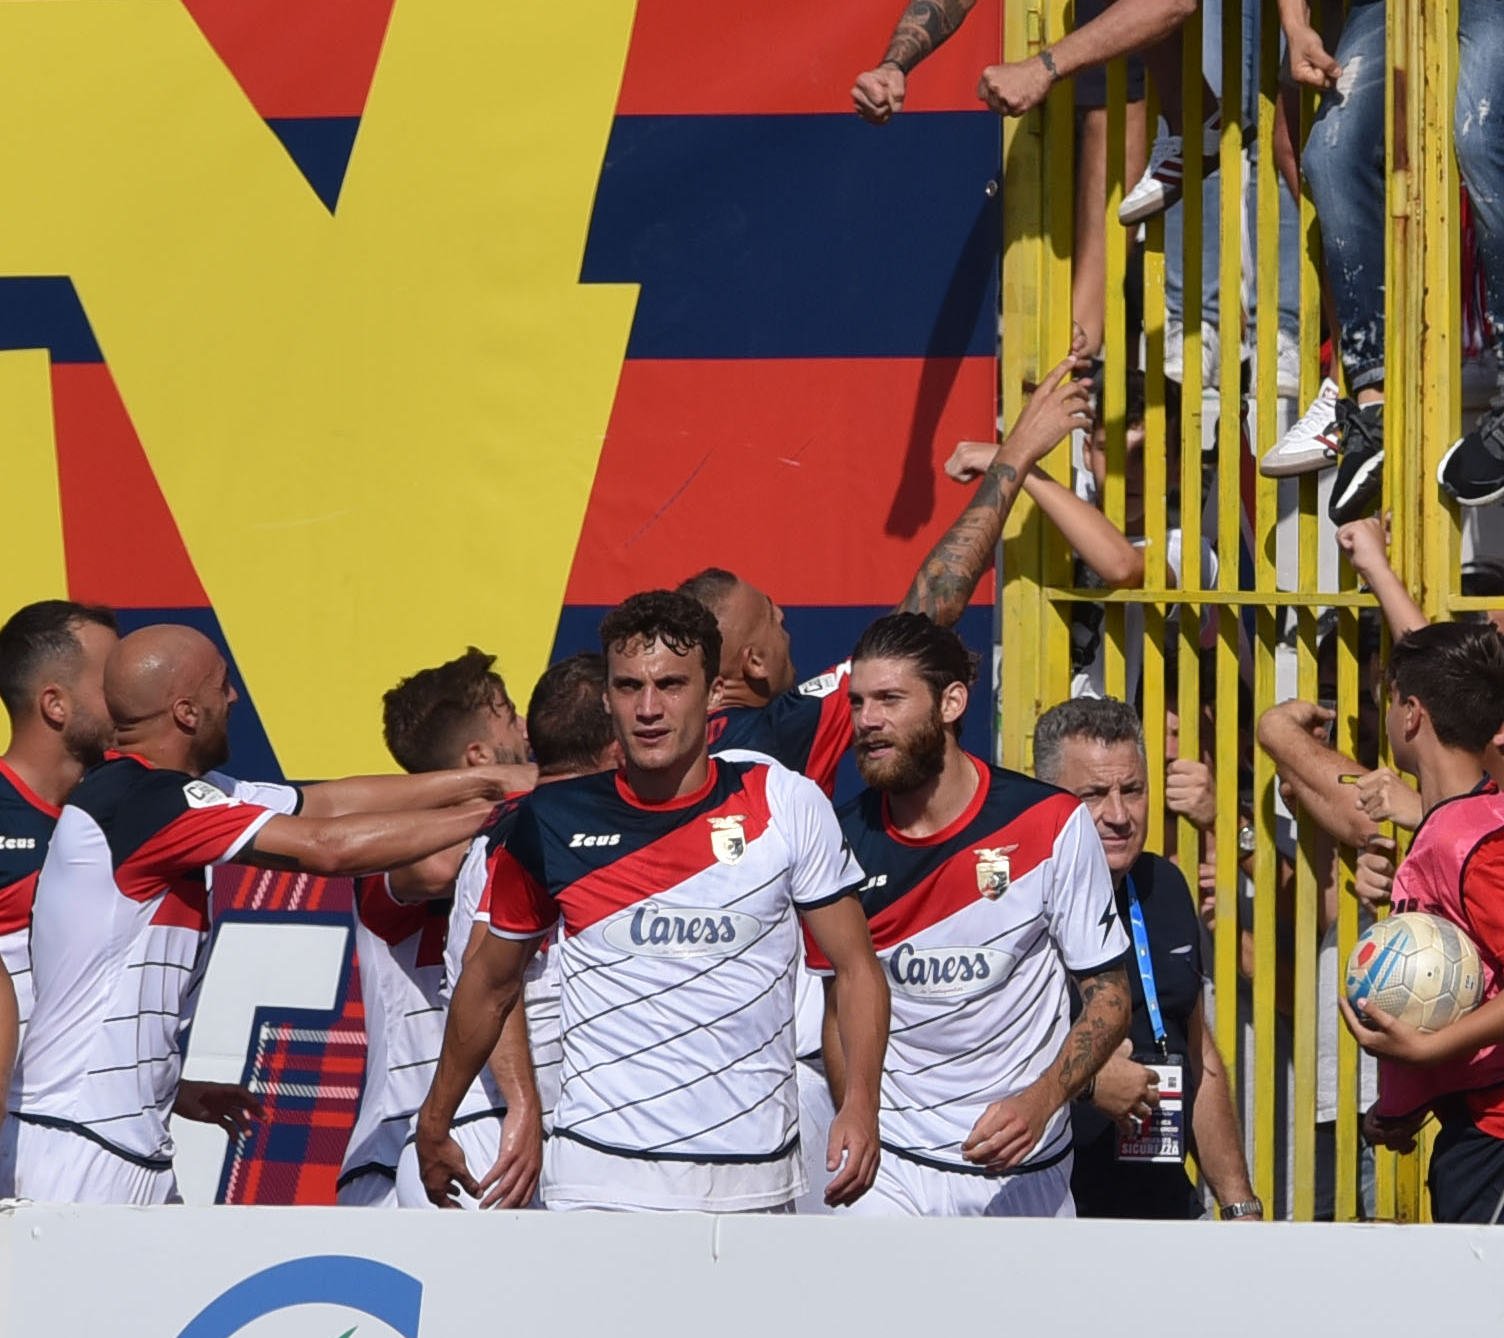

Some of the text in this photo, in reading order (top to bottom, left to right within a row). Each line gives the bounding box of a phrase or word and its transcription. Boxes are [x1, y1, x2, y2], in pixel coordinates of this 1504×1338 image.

[568, 833, 622, 849] Zeus
[866, 874, 889, 891] us
[628, 901, 737, 947] Caress
[889, 942, 992, 986] Caress
[1121, 1132, 1180, 1159] SICUREZZA
